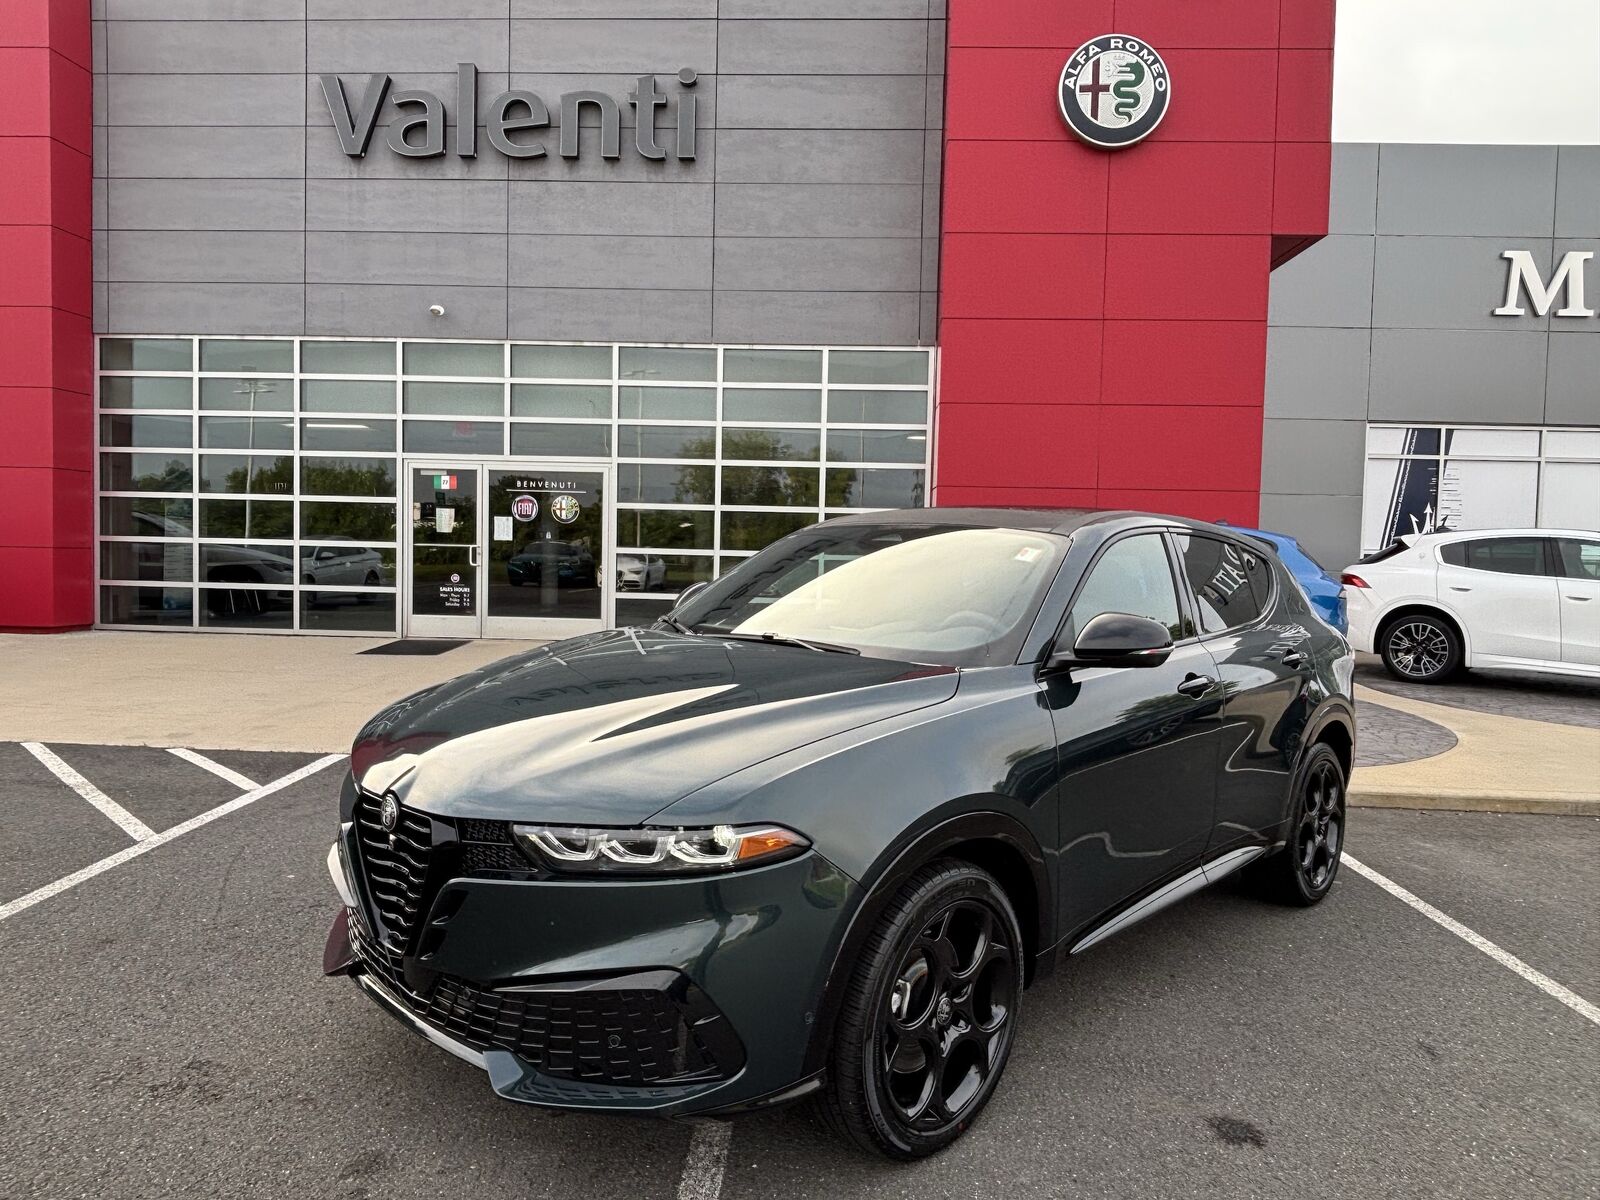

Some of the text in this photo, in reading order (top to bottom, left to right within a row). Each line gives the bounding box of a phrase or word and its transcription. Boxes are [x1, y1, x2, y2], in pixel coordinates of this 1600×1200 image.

[1064, 38, 1166, 92] ALFA ROMEO
[319, 62, 698, 160] Valenti
[516, 480, 577, 489] BENVENUTI
[517, 502, 533, 515] FIAT
